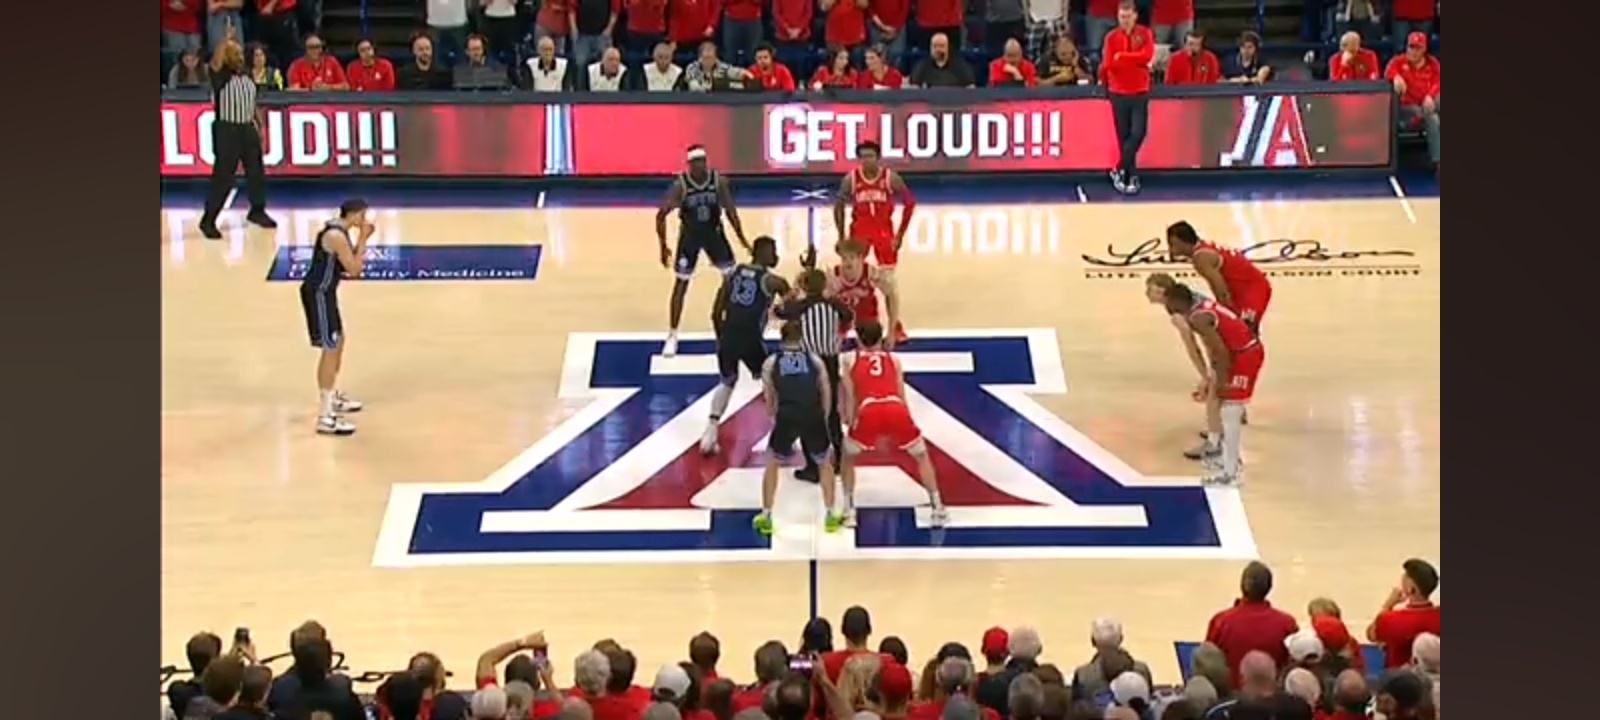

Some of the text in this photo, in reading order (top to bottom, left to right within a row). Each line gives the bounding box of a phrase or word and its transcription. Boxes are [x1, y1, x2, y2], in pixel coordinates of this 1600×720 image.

[768, 105, 1061, 164] GET LOUD!!!
[869, 355, 883, 376] 3
